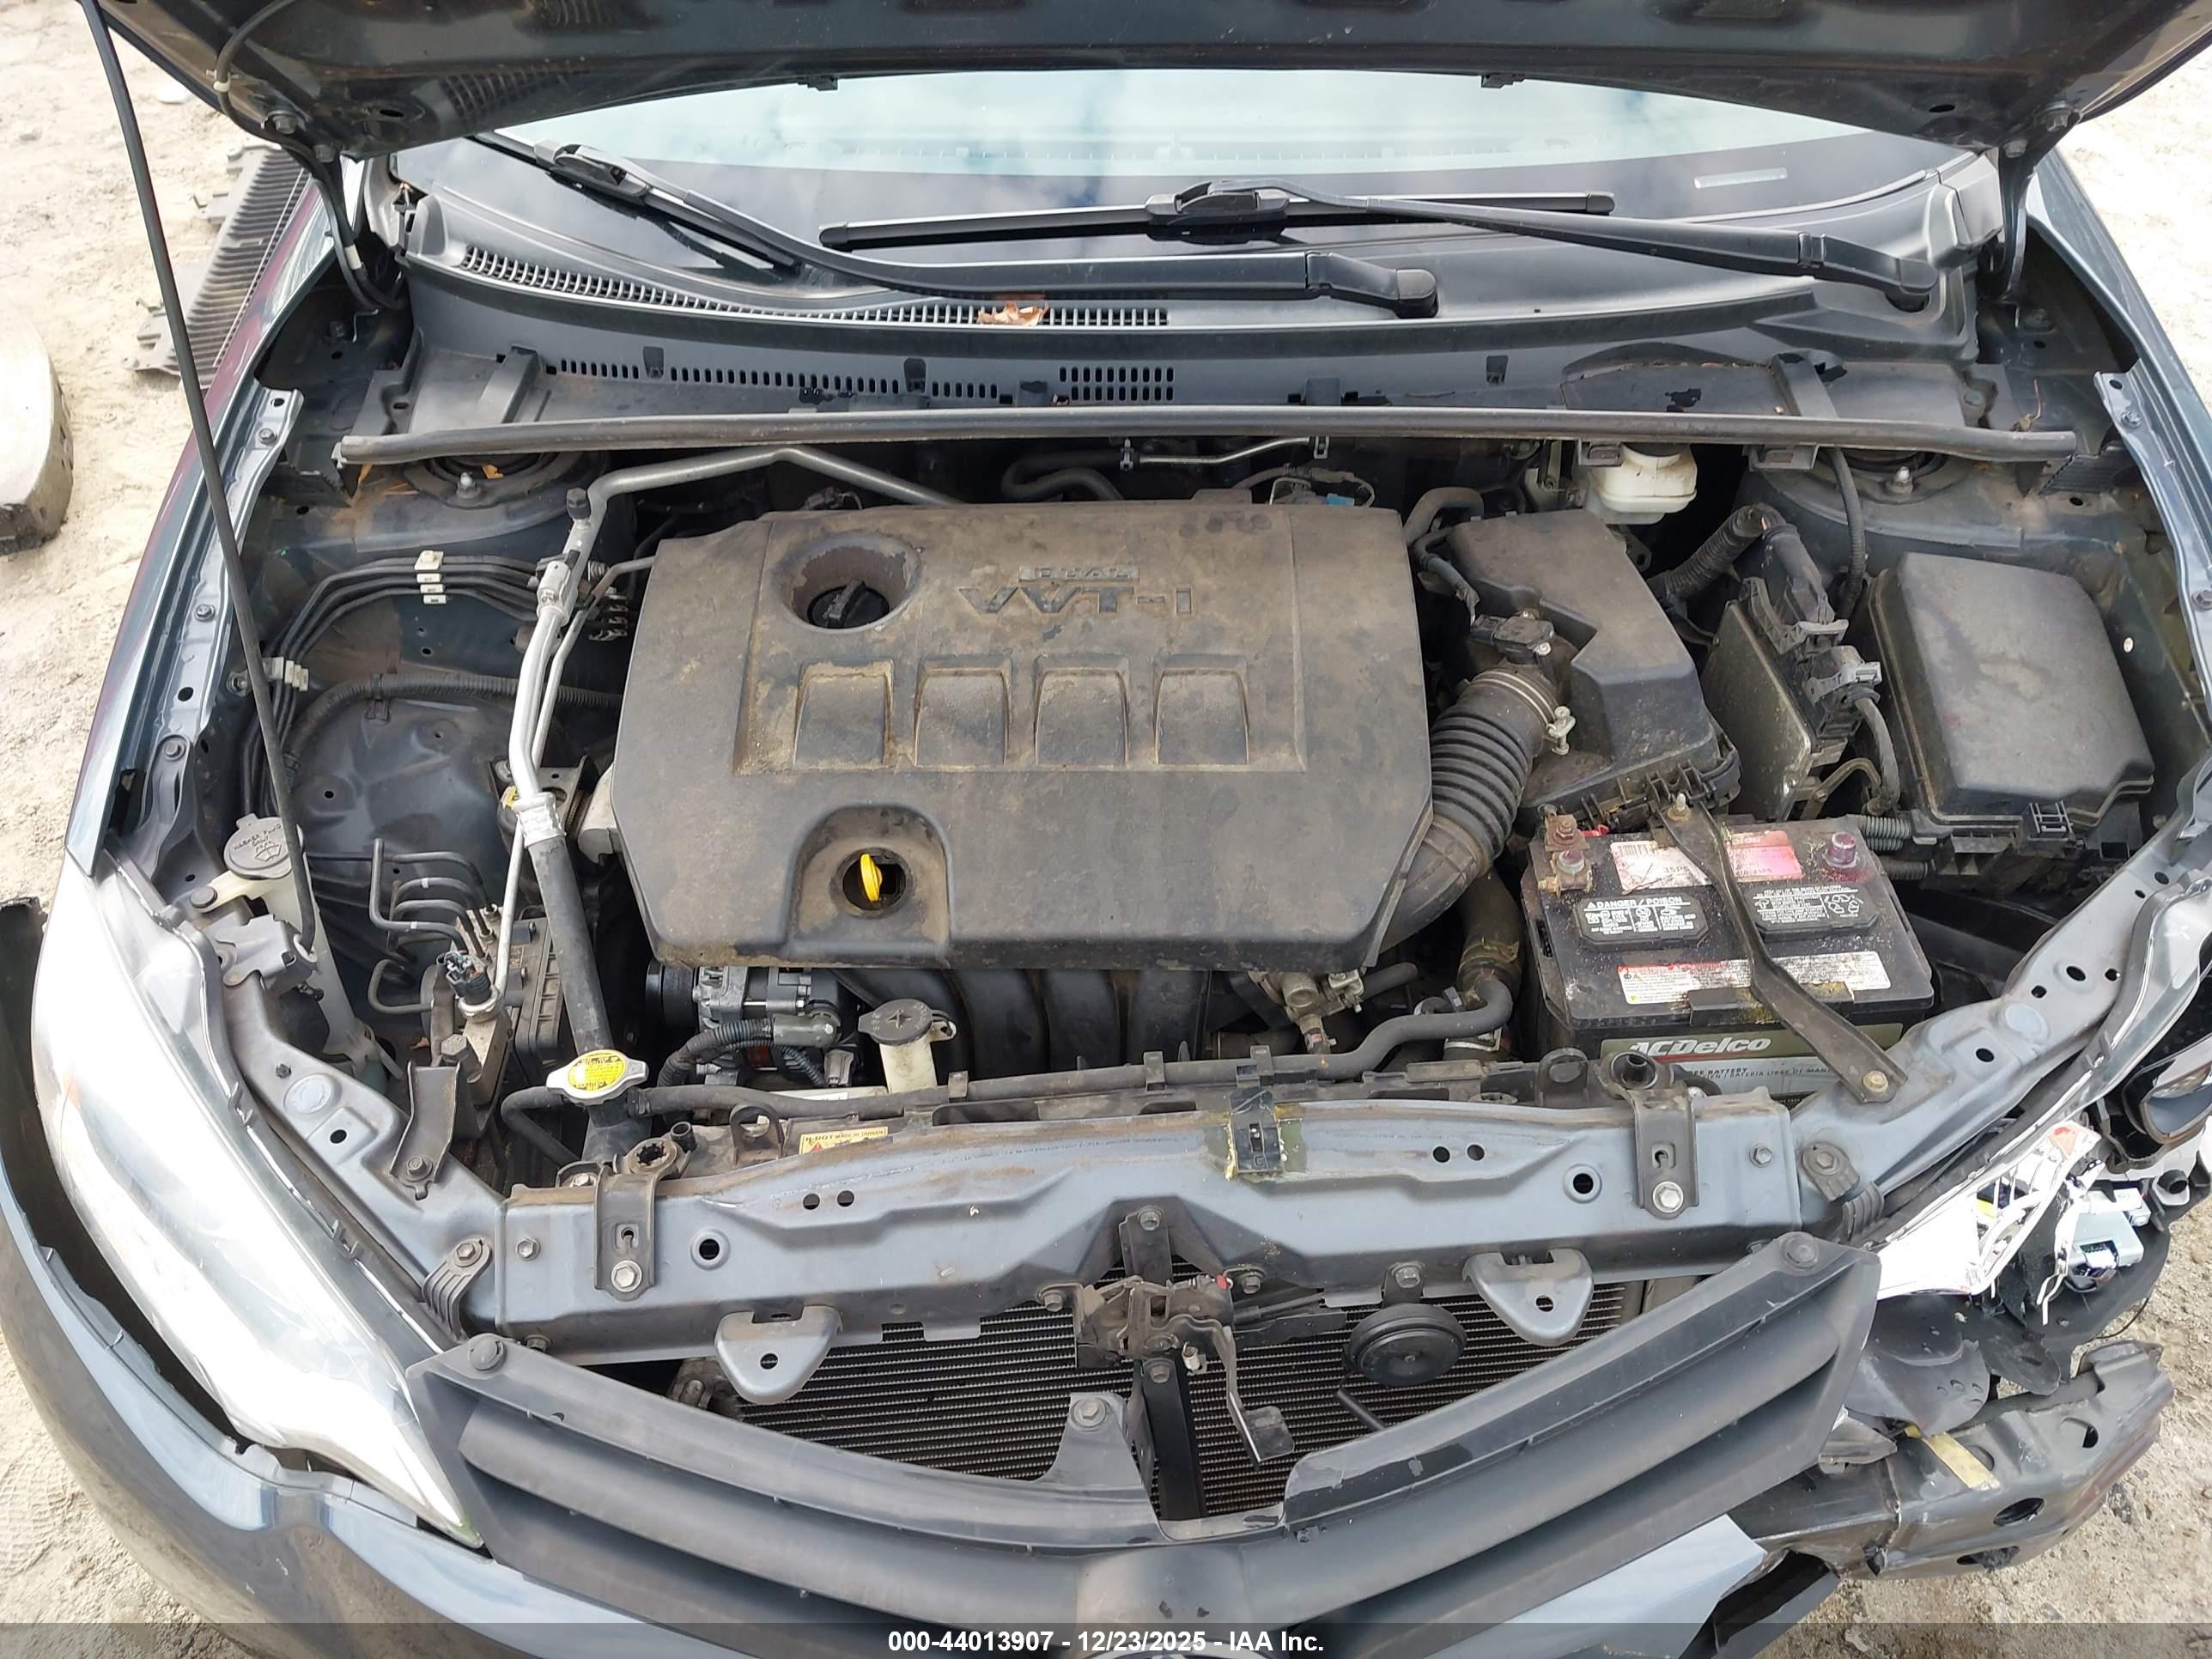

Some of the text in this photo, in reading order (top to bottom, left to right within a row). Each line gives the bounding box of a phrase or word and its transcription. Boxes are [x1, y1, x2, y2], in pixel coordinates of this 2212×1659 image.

[1034, 566, 1132, 580] DUAL
[1597, 899, 1637, 909] DANGER
[1645, 896, 1683, 905] POISON
[1629, 1037, 1771, 1055] ACDelco
[1707, 1066, 1748, 1075] BATTERY
